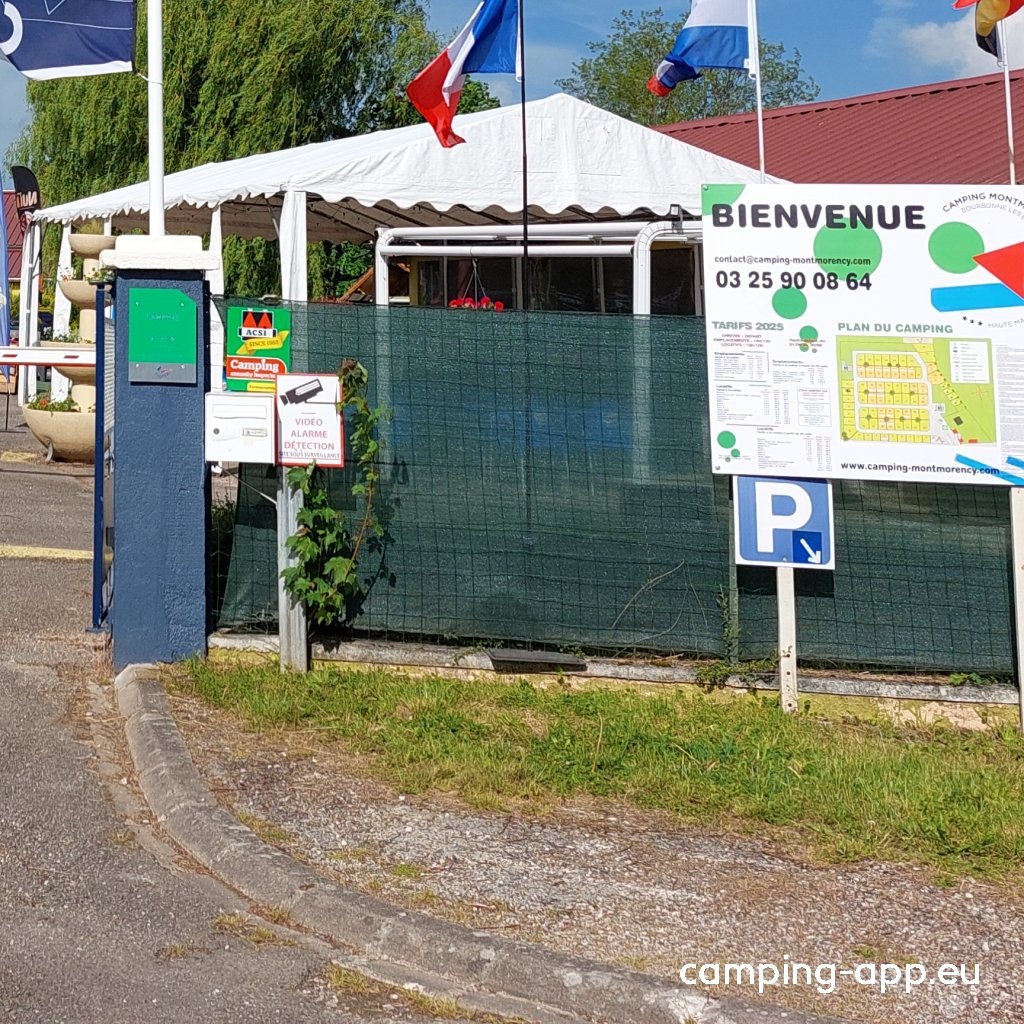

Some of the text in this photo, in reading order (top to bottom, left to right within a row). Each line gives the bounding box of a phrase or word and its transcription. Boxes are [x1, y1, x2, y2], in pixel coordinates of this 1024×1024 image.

[942, 193, 987, 213] CAMPING
[960, 202, 1007, 214] BOURBONNE
[711, 204, 926, 230] BIENVENUE
[714, 255, 871, 267] contact@camping-montmorency.com
[716, 270, 872, 290] 03 25 90 08 64
[712, 321, 784, 331] TARIFS 2025
[838, 322, 953, 333] PLAN DU CAMPING
[230, 358, 279, 374] Camping
[291, 430, 328, 438] ALARME
[284, 440, 334, 450] DÉTECTION
[841, 462, 999, 475] www.camping-montmorency.com
[755, 482, 812, 553] P
